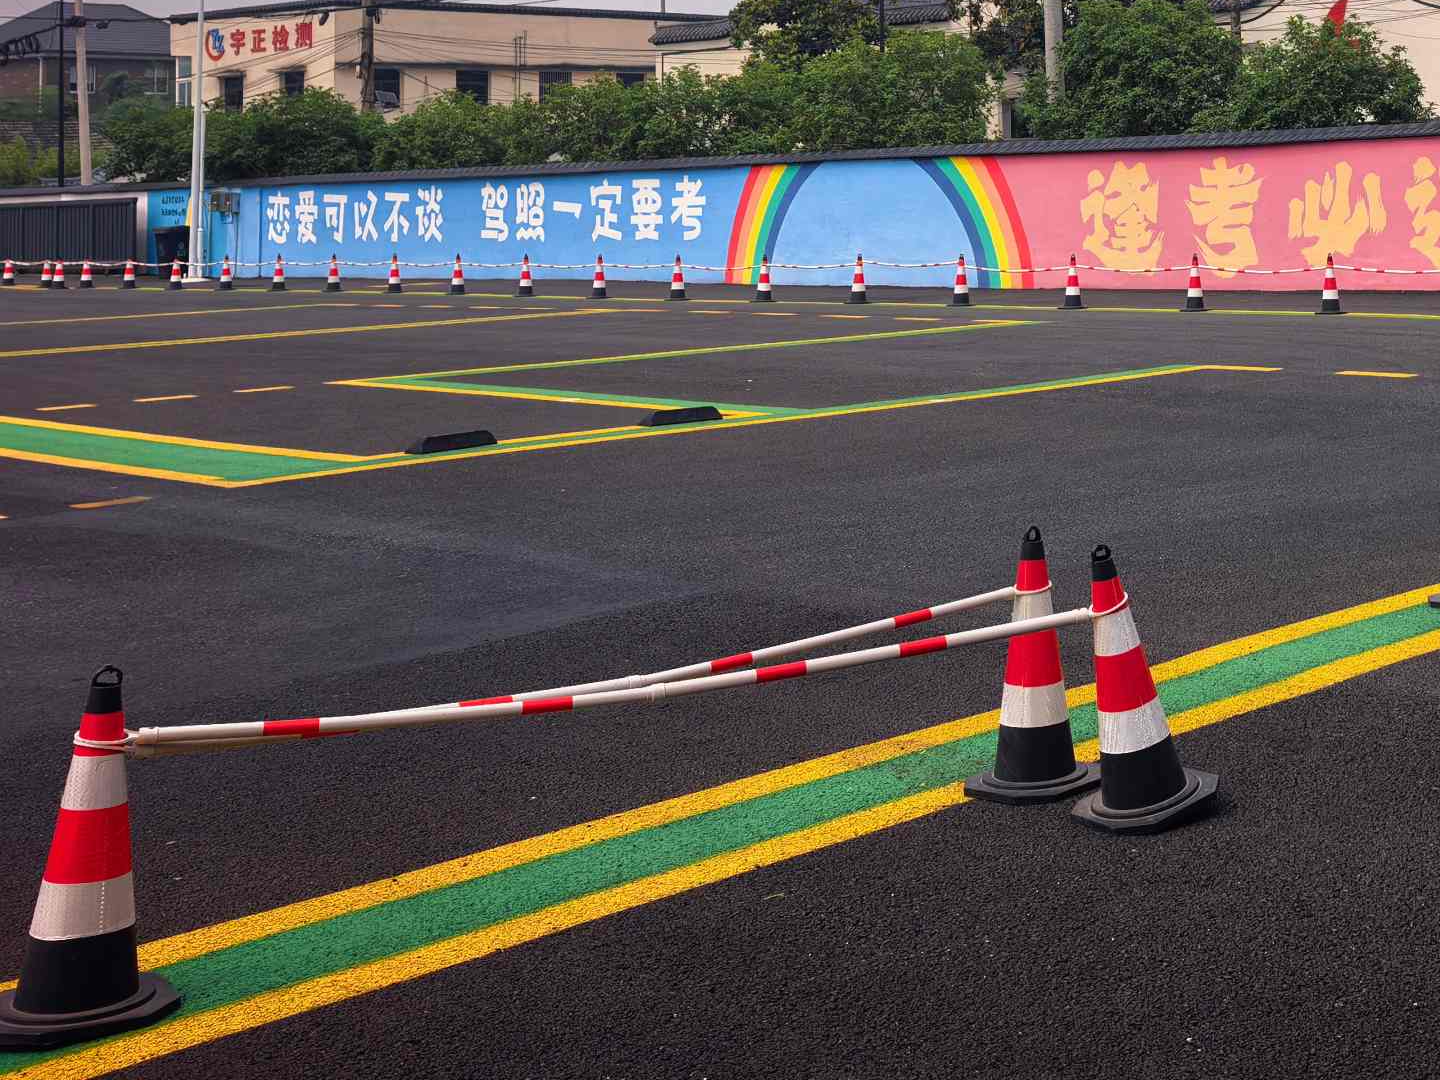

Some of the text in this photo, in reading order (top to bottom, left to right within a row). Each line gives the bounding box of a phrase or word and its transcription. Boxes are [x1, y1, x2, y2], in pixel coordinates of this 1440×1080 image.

[230, 22, 313, 56] 宇正检测
[267, 175, 706, 245] 恋爱可以不谈 驾照一定要考
